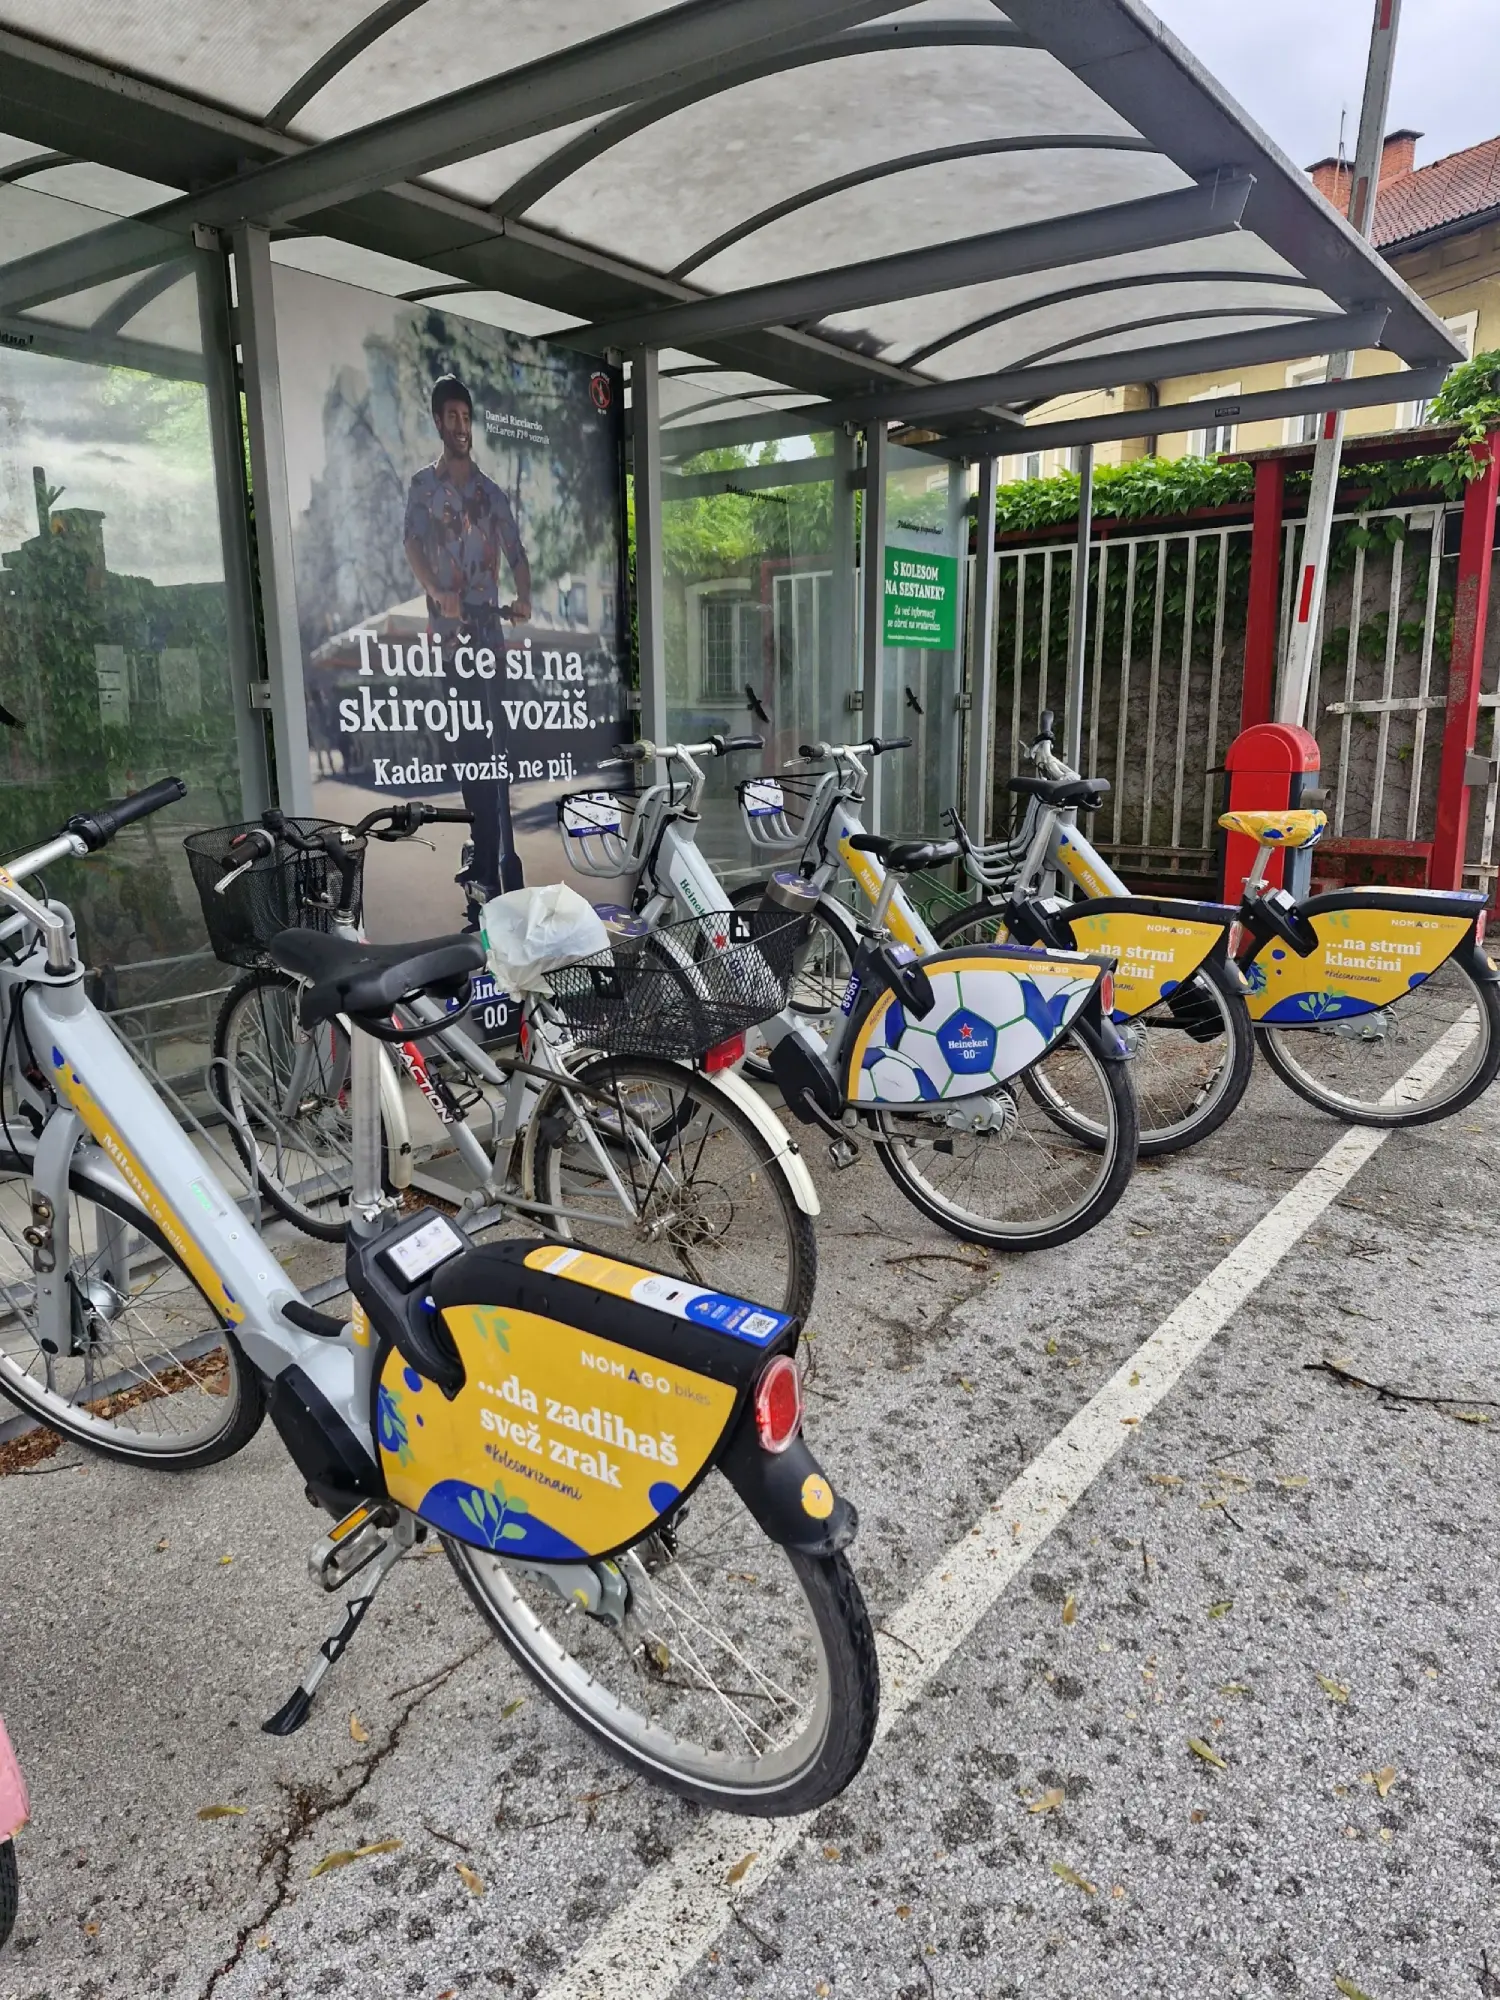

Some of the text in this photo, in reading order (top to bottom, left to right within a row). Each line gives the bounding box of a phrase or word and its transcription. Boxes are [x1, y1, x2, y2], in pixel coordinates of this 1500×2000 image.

[485, 410, 543, 431] Daniel Ricciardo
[486, 423, 515, 438] McLaren
[893, 561, 939, 581] S KOLESOM
[885, 579, 945, 601] NA SESTANEK?
[350, 629, 584, 681] Tudi če si na
[339, 686, 614, 742] skiroju, voziš...
[373, 753, 577, 786] Kadar voziš, ne pij.
[1146, 923, 1192, 936] NOMAGO
[1391, 919, 1439, 929] NOMAGO
[1084, 943, 1175, 962] ...na strmi
[1326, 938, 1422, 956] ...na strmi
[1325, 951, 1401, 972] klančini
[843, 976, 860, 1009] 89561
[484, 1003, 508, 1029] 0.0
[948, 1038, 989, 1049] Heineken
[580, 1350, 711, 1406] NOMAGO bikes
[478, 1374, 679, 1467] ...da zadihaš
[480, 1407, 623, 1489] svež zrak
